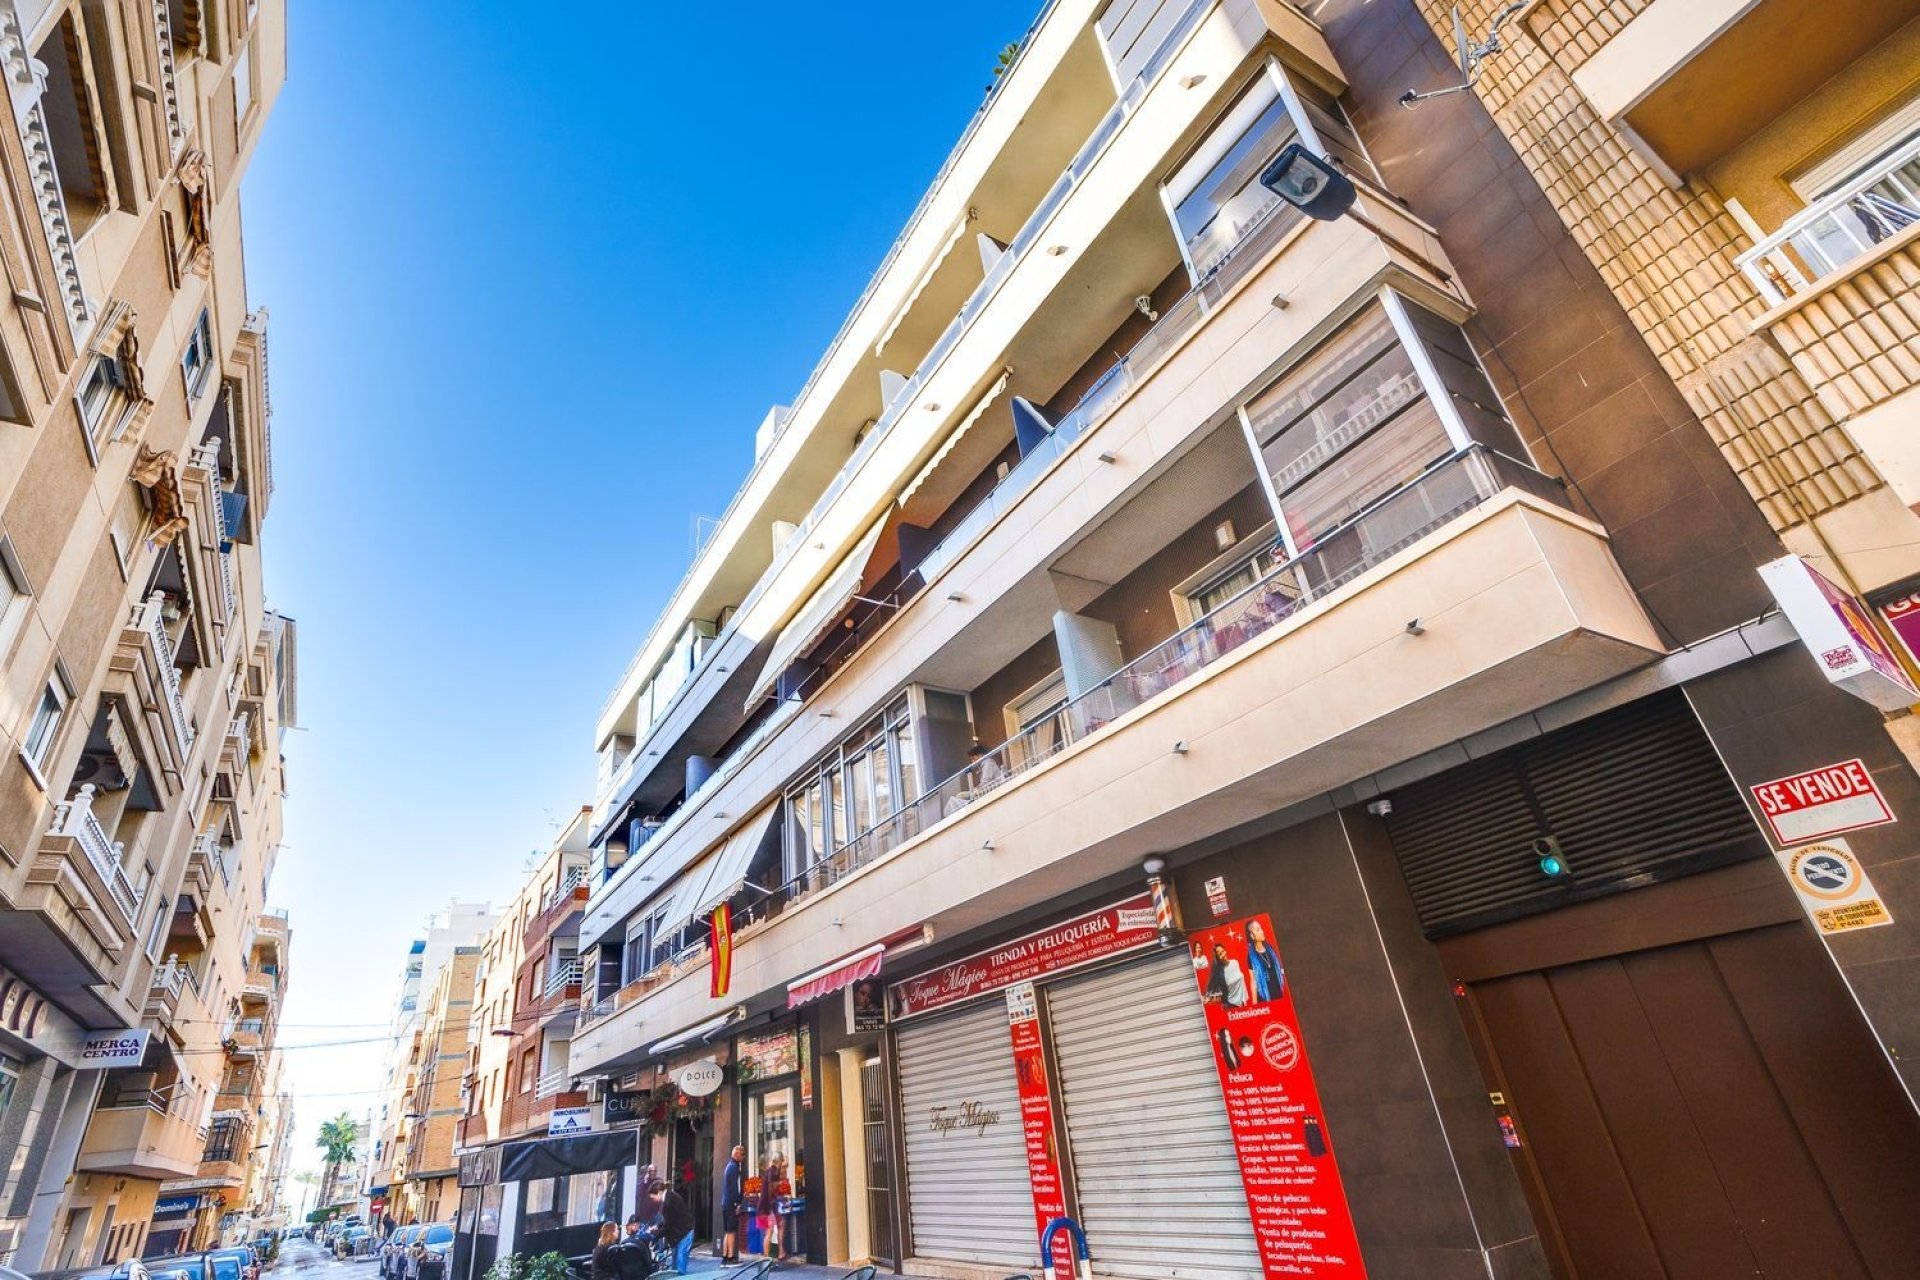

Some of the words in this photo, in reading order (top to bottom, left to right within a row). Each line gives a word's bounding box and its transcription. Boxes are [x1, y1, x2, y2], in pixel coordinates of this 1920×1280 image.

[1758, 785, 1791, 814] SE
[1783, 764, 1870, 806] VENDE
[990, 945, 1027, 967] TIENDA
[1028, 941, 1036, 954] Y
[1037, 915, 1111, 951] PELUQUERÍA
[909, 978, 939, 1006] Toque
[1228, 1006, 1271, 1020] Extensiones
[85, 1038, 140, 1050] MERCA
[82, 1048, 139, 1059] CENTRO
[686, 1070, 716, 1081] DOLCE
[1228, 1073, 1254, 1083] Peluca
[1243, 1087, 1259, 1095] 100%
[1260, 1084, 1284, 1094] Natural
[1246, 1098, 1262, 1106] 100%
[1263, 1095, 1289, 1104] Humano
[1248, 1108, 1264, 1116] 100%
[1265, 1106, 1280, 1114] Semi
[1281, 1103, 1306, 1113] Natural
[1238, 1133, 1263, 1142] Tenemos
[155, 1201, 189, 1214] Domino's
[1291, 1228, 1326, 1239] productos
